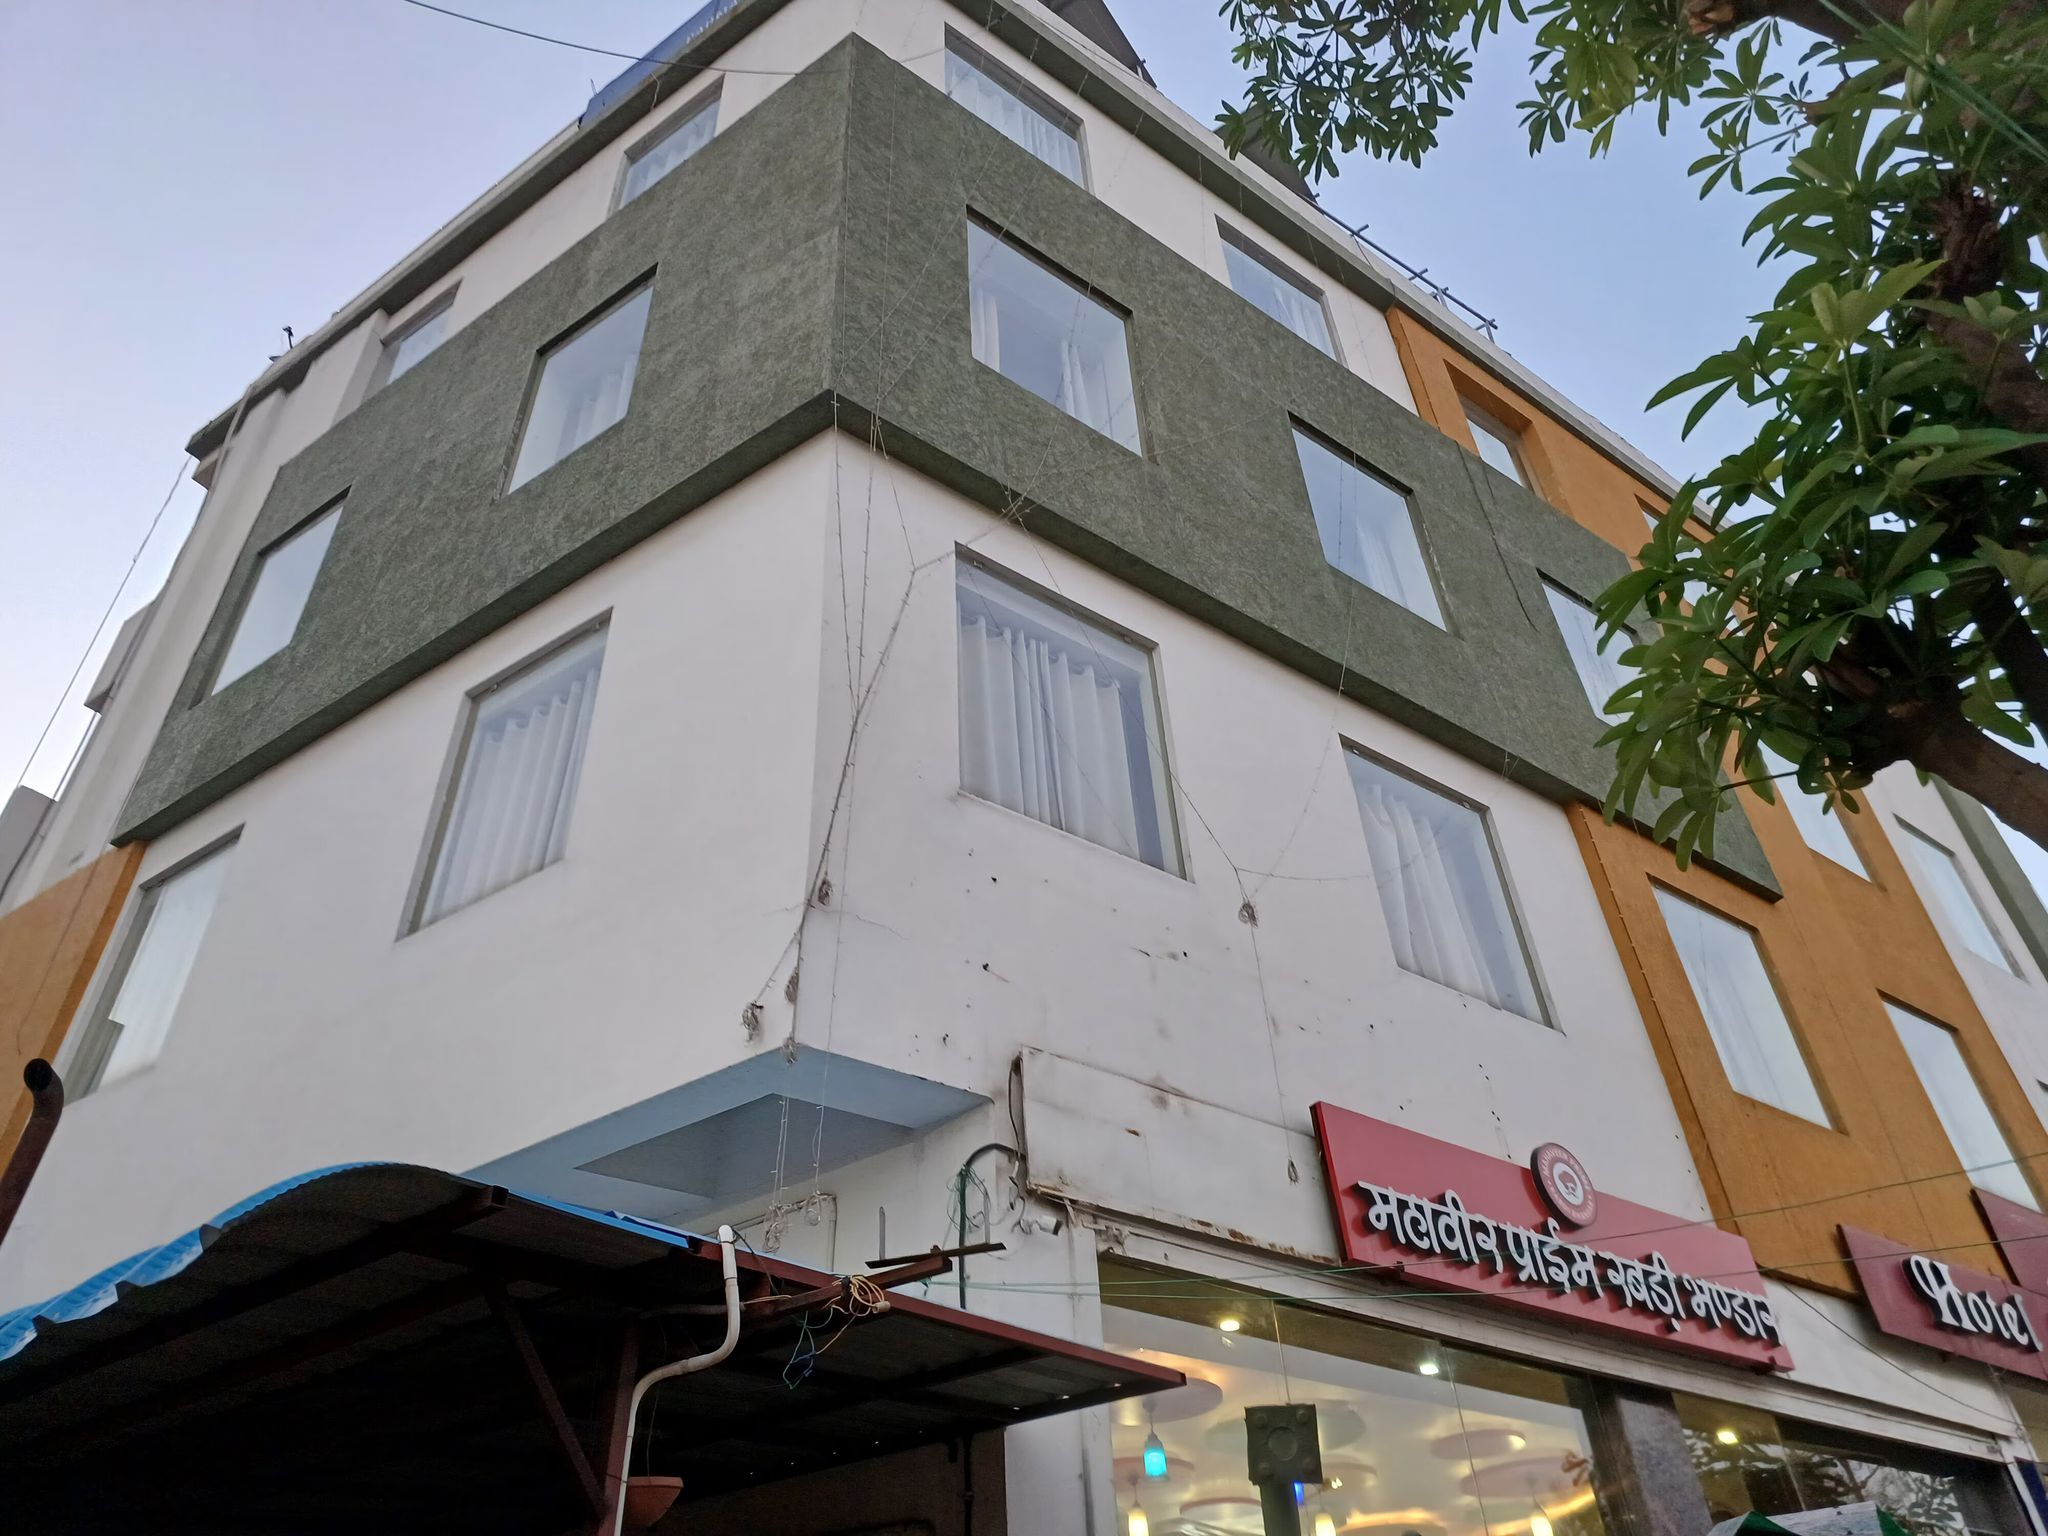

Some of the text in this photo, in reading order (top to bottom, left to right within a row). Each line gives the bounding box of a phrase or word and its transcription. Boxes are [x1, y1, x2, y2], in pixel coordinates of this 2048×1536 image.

[1358, 1180, 1504, 1273] महावीर
[1499, 1217, 1604, 1298] प्राईम
[1598, 1250, 1686, 1332] रबड़ी
[1680, 1273, 1782, 1347] भण्डार
[1910, 1254, 2043, 1352] Hotel
